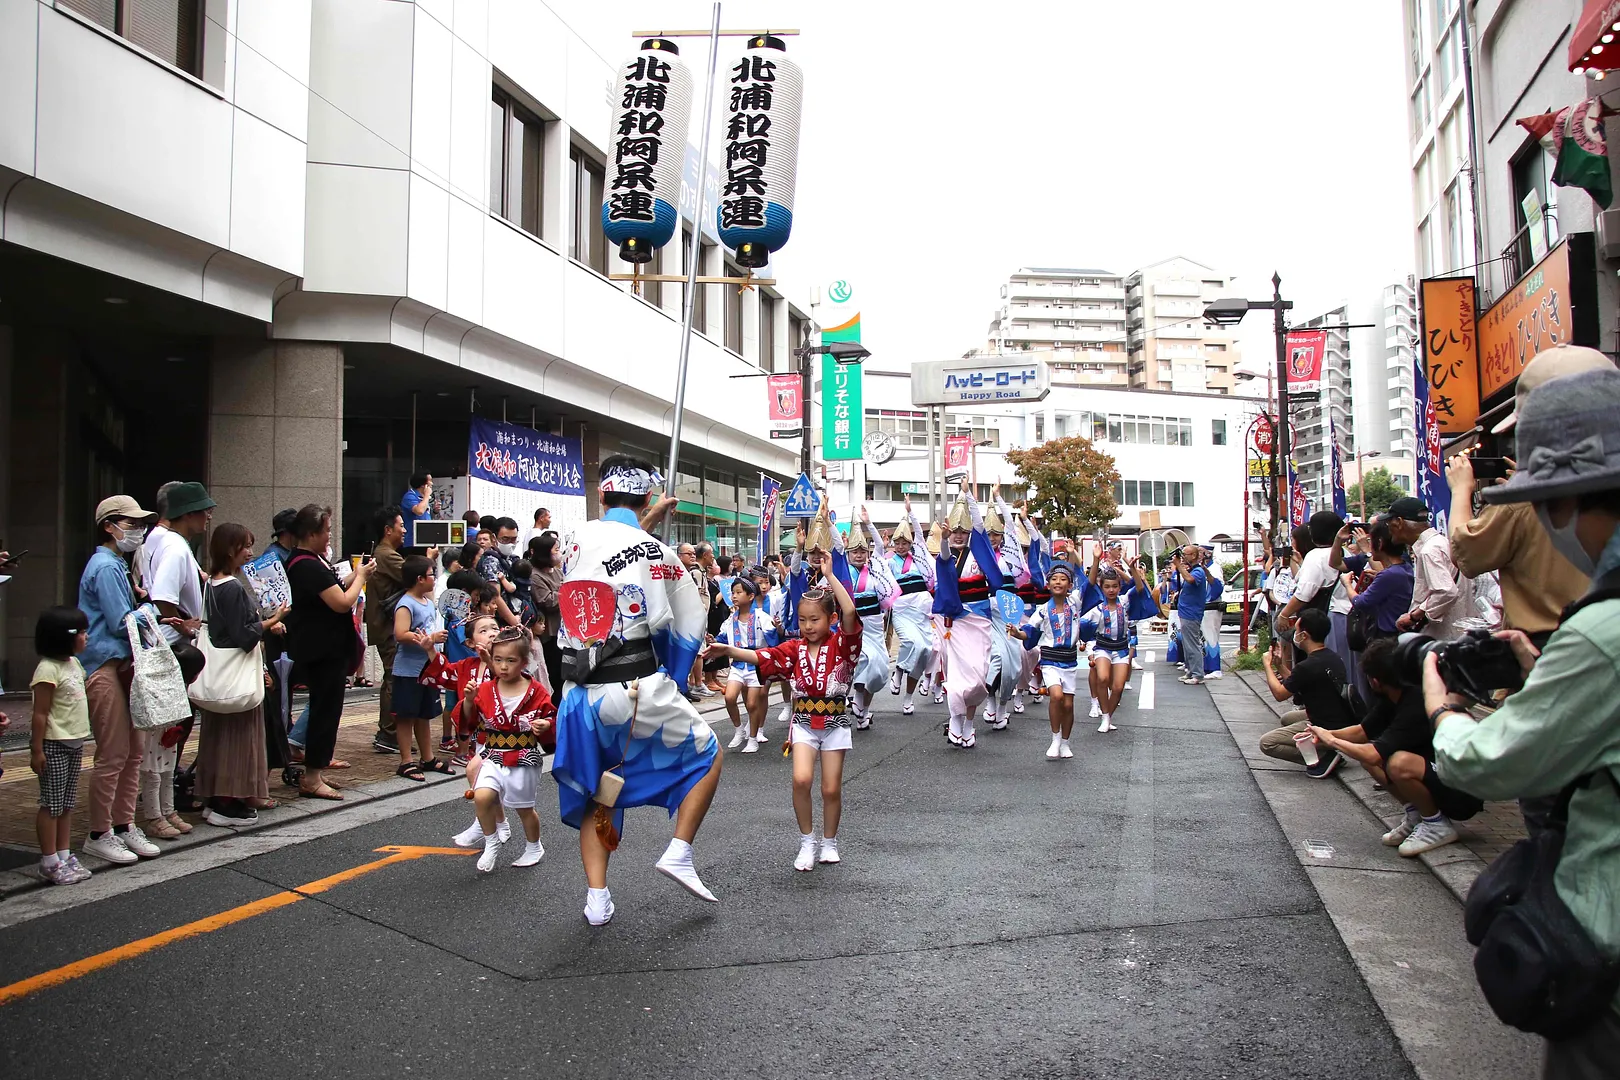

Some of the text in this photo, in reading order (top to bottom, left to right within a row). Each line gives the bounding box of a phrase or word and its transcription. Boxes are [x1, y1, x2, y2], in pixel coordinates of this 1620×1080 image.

[608, 56, 671, 221] 北浦和阿呆連
[722, 56, 777, 228] 北浦和阿呆連
[1455, 282, 1473, 352] やきとり
[945, 370, 1036, 388] ハッピーロード
[960, 390, 1021, 400] Happy Road
[1429, 328, 1463, 425] ひびき
[1485, 331, 1516, 388] やきとり
[834, 361, 850, 450] 玉りそな銀行
